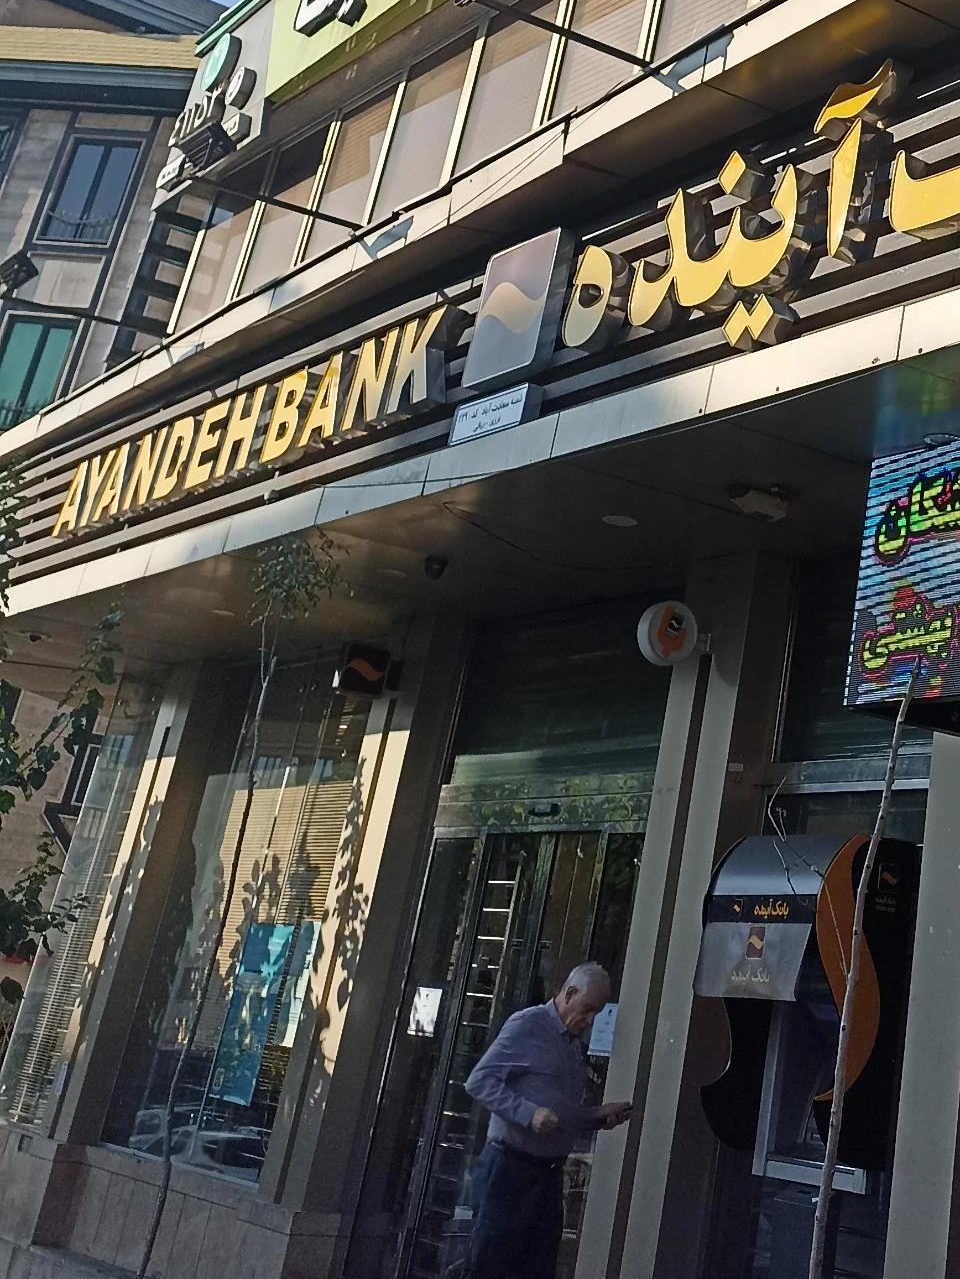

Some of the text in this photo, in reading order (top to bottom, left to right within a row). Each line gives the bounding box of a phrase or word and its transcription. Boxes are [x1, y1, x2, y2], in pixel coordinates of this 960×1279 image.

[561, 57, 895, 348] آینده
[50, 305, 450, 540] AYANDEH BANK
[862, 602, 953, 670] بهشتی
[753, 898, 790, 919] بانک آینده
